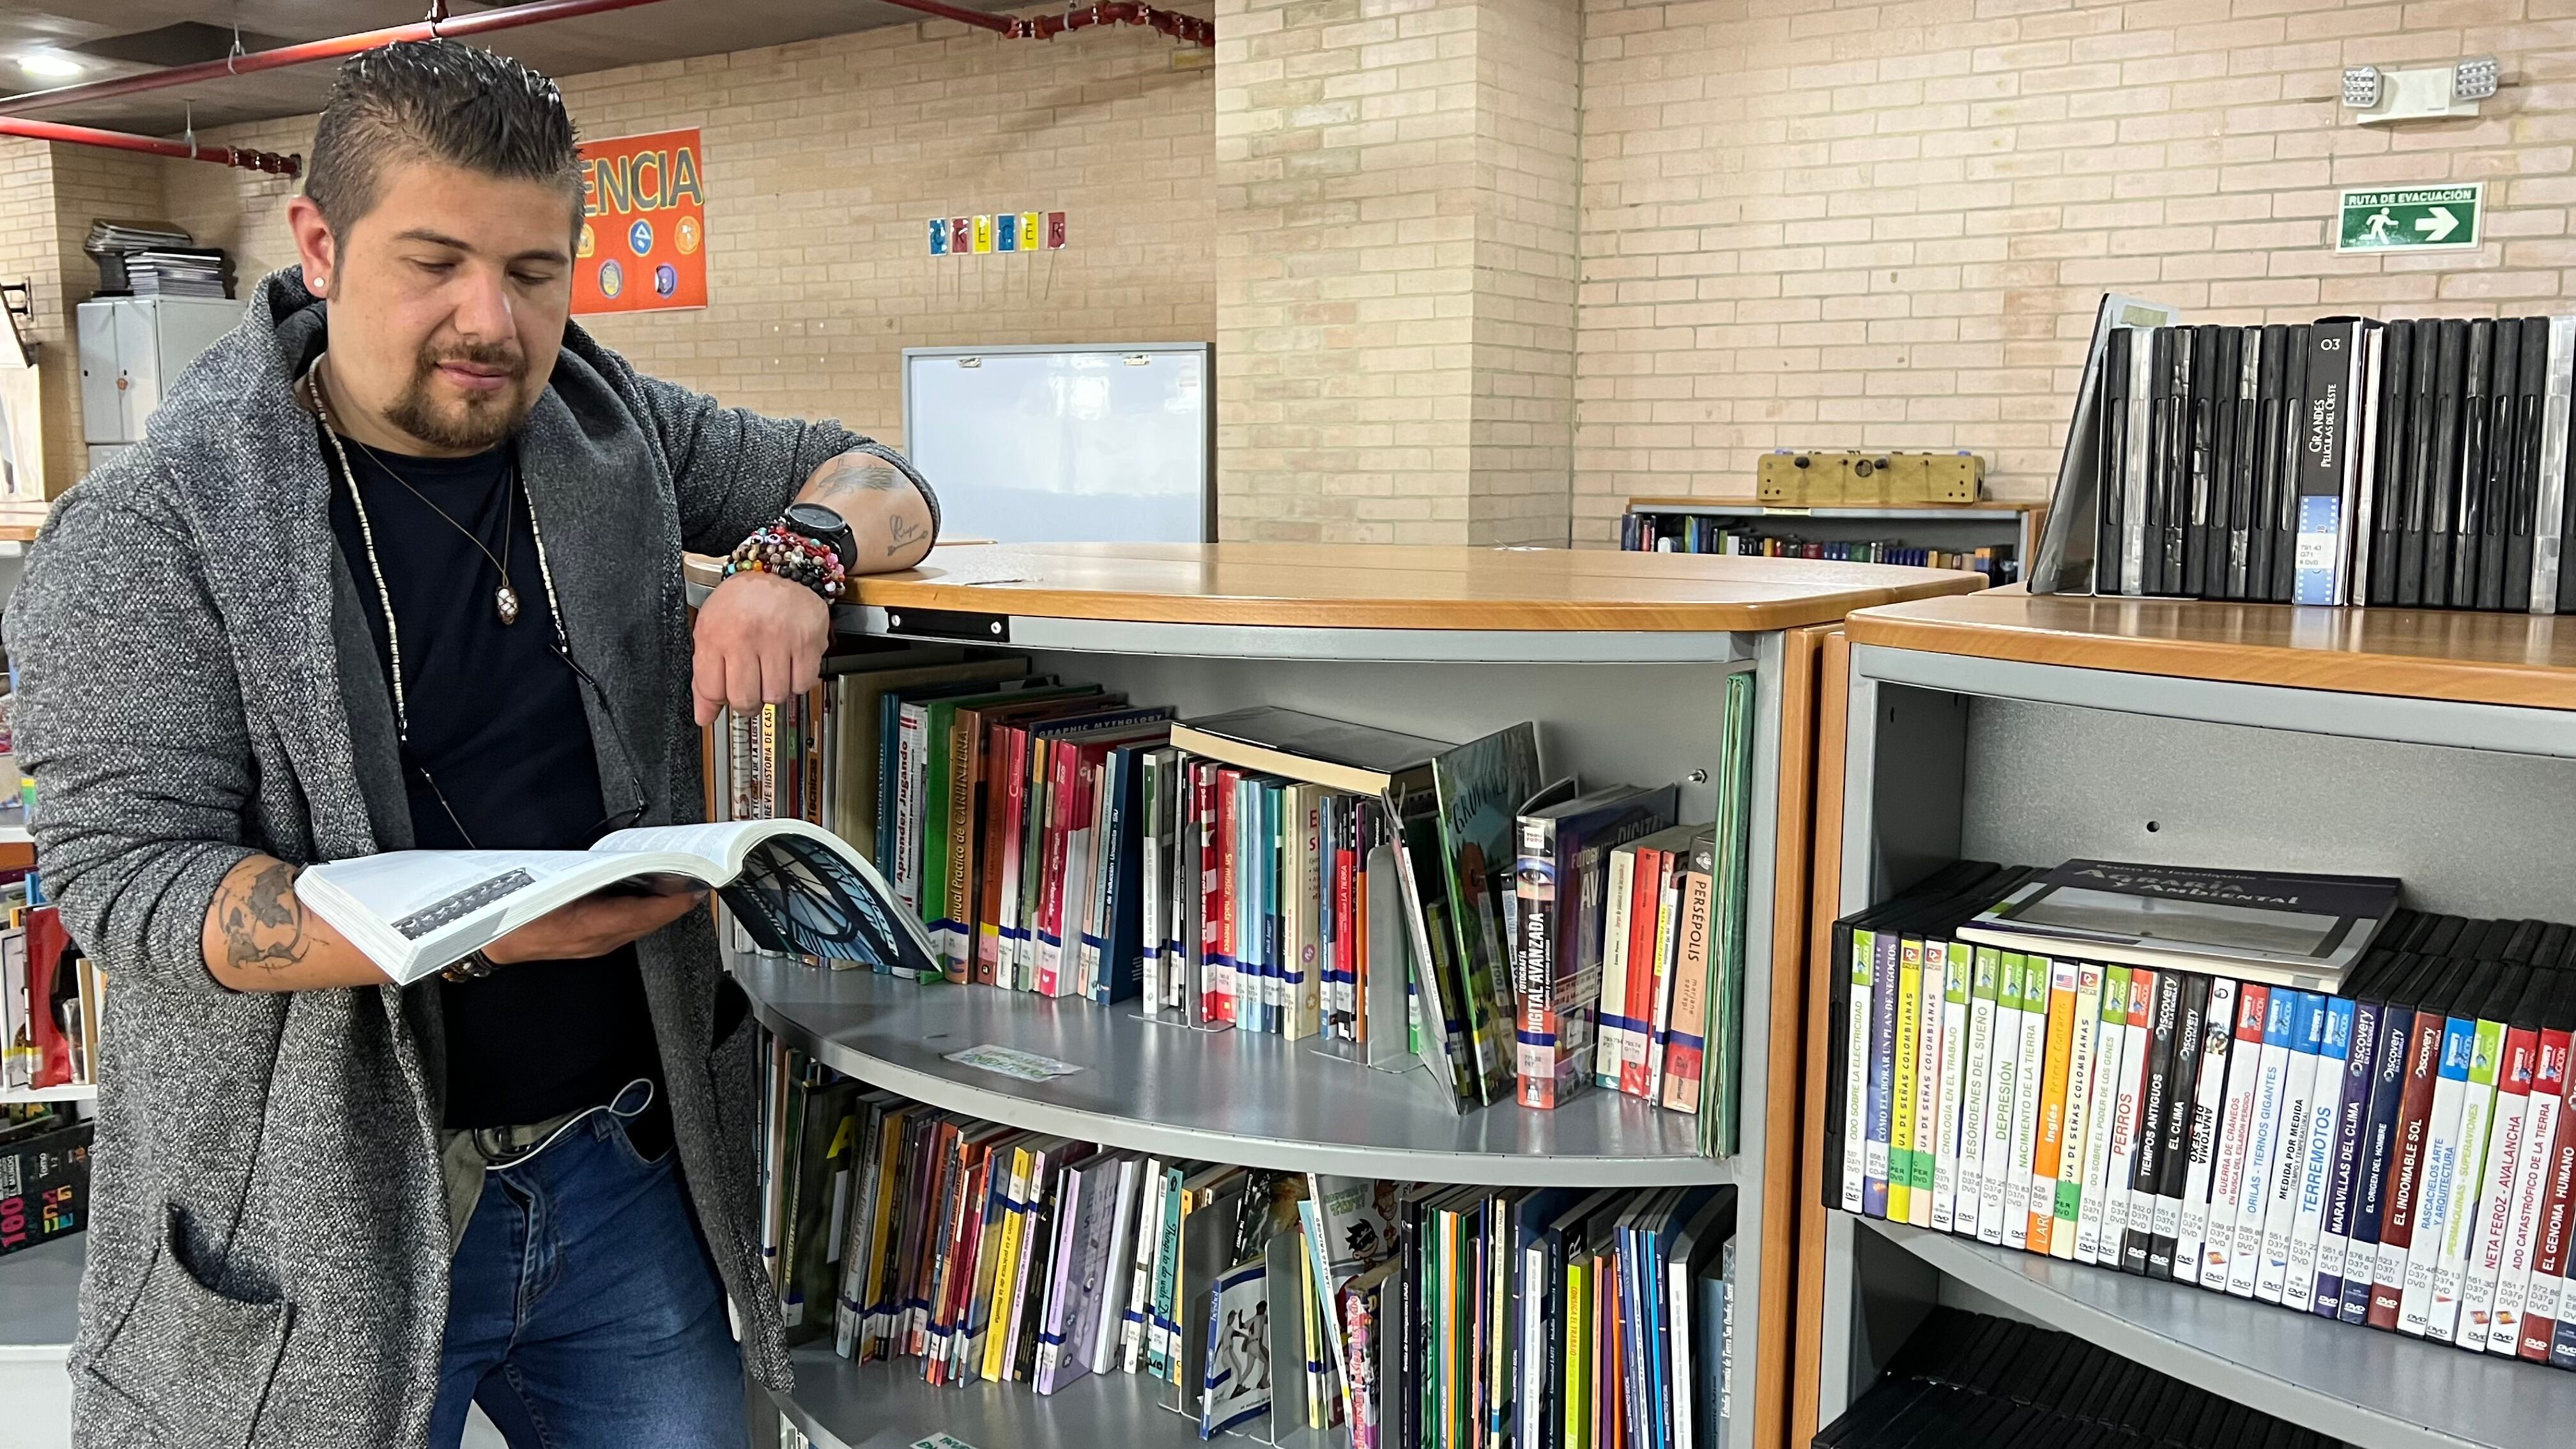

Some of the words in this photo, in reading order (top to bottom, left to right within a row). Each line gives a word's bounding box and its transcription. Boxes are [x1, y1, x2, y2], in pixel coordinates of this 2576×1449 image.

[2349, 194, 2378, 205] RUTA
[2380, 194, 2396, 204] DE
[2325, 383, 2336, 410] OESTE
[2308, 399, 2325, 452] GRANDES
[2326, 411, 2334, 425] DEL
[764, 707, 772, 728] CASI
[1038, 724, 1089, 737] GRAPHIC
[1094, 714, 1163, 729] MYTHOLOGY
[764, 732, 772, 744] DE
[764, 751, 772, 788] HISTORIA
[899, 740, 908, 806] Jugando
[896, 809, 907, 883] Aprender
[957, 827, 965, 841] de
[952, 845, 965, 891] Práctico
[952, 893, 963, 923] anual
[1107, 894, 1112, 905] de
[1688, 880, 1707, 962] PERSÉPOLIS
[1528, 913, 1544, 985] AVANZADA
[1885, 943, 1897, 993] NEGOCIOS
[1528, 987, 1544, 1033] DIGITAL
[1689, 978, 1698, 1015] marjane
[2155, 976, 2177, 1041] Discovery
[1853, 1000, 1862, 1068] ELECTRICIDAD
[1883, 1011, 1892, 1038] PLAN
[1903, 992, 1913, 1070] COLOMBIANAS
[1924, 993, 1936, 1070] COLOMBIANAS
[1975, 1006, 1988, 1049] SUEÑO
[2179, 1008, 2199, 1061] Discovery
[1947, 1027, 1957, 1068] TRABAJO
[2025, 1024, 2036, 1063] TIERRA
[2074, 1018, 2089, 1099] COLOMBIANAS
[2104, 1036, 2114, 1065] GENES
[2350, 1009, 2374, 1077] Discovery
[2383, 1028, 2404, 1082] Discovery
[2415, 1027, 2436, 1079] Discovery
[1852, 1070, 1860, 1085] LA
[1947, 1074, 1955, 1085] EL
[1972, 1052, 1984, 1077] DEL
[2024, 1065, 2034, 1080] LA
[1880, 1055, 1890, 1110] ELABORAR
[1899, 1074, 1910, 1108] SEÑAS
[1922, 1075, 1931, 1110] SEÑAS
[1946, 1091, 1954, 1103] EN
[2023, 1083, 2032, 1098] DE
[2100, 1085, 2108, 1098] DE
[1850, 1087, 1860, 1117] SOBRE
[1995, 1061, 2012, 1140] DEPRESIÓN
[2097, 1099, 2106, 1128] PODER
[2195, 1103, 2205, 1126] DEL
[2254, 1128, 2267, 1167] TIERNOS
[2261, 1066, 2277, 1120] GIGANTES
[1878, 1111, 1887, 1142] CÓMO
[1899, 1113, 1907, 1128] DE
[1922, 1116, 1929, 1130] DE
[2019, 1100, 2032, 1168] NACIMIENTO
[2044, 1103, 2057, 1143] Inglés
[2069, 1104, 2080, 1139] SEÑAS
[2113, 1093, 2133, 1156] PERROS
[2140, 1130, 2156, 1176] TIEMPOS
[2148, 1073, 2163, 1129] ANTIGUOS
[2170, 1101, 2185, 1135] CLIMA
[2290, 1099, 2304, 1139] MEDIDA
[2345, 1101, 2360, 1137] CLIMA
[2407, 1119, 2423, 1142] SOL
[2536, 1103, 2551, 1139] TIERRA
[2067, 1144, 2076, 1159] DE
[2168, 1138, 2179, 1151] EL
[2189, 1131, 2201, 1163] SEXO
[2197, 1107, 2213, 1165] ANATOMÍA
[2218, 1159, 2230, 1195] GUERRA
[2226, 1098, 2240, 1140] CRÁNEOS
[2287, 1142, 2296, 1159] POR
[2341, 1138, 2354, 1161] DEL
[2375, 1123, 2388, 1156] HOMBRE
[2534, 1140, 2543, 1154] LA
[38, 1152, 49, 1178] Tomo
[2302, 1106, 2331, 1214] TERREMOTOS
[2373, 1157, 2381, 1173] DEL
[2396, 1144, 2418, 1209] INDOMABLE
[2493, 1197, 2507, 1236] FEROZ
[2503, 1116, 2522, 1190] AVALANCHA
[2531, 1155, 2541, 1170] DE
[2556, 1146, 2575, 1199] HUMANO
[2279, 1162, 2292, 1200] MEDIDA
[2368, 1174, 2379, 1203] ORIGEN
[2421, 1163, 2438, 1230] RASCACIELOS
[2434, 1137, 2444, 1162] ARTE
[2435, 1146, 2455, 1218] ARQUITECTURA
[2331, 1163, 2351, 1234] MARAVILLAS
[2365, 1204, 2374, 1214] EL
[2516, 1172, 2538, 1246] CATASTRÓFICO
[0, 1196, 27, 1248] 100
[1164, 1219, 1177, 1254] Things
[2393, 1213, 2405, 1227] EL
[2545, 1204, 2565, 1253] GENOMA
[1001, 1250, 1010, 1277] práctica
[1161, 1266, 1172, 1278] do
[1163, 1254, 1170, 1265] to
[2542, 1258, 2556, 1271] EL
[999, 1278, 1006, 1287] de
[1159, 1280, 1170, 1301] with
[1724, 1283, 1734, 1301] Sucre
[1569, 1285, 1579, 1316] CONSIGA
[1570, 1317, 1578, 1326] EL
[1724, 1326, 1733, 1338] San
[1569, 1326, 1578, 1356] TRABAJO
[1723, 1358, 1732, 1367] de
